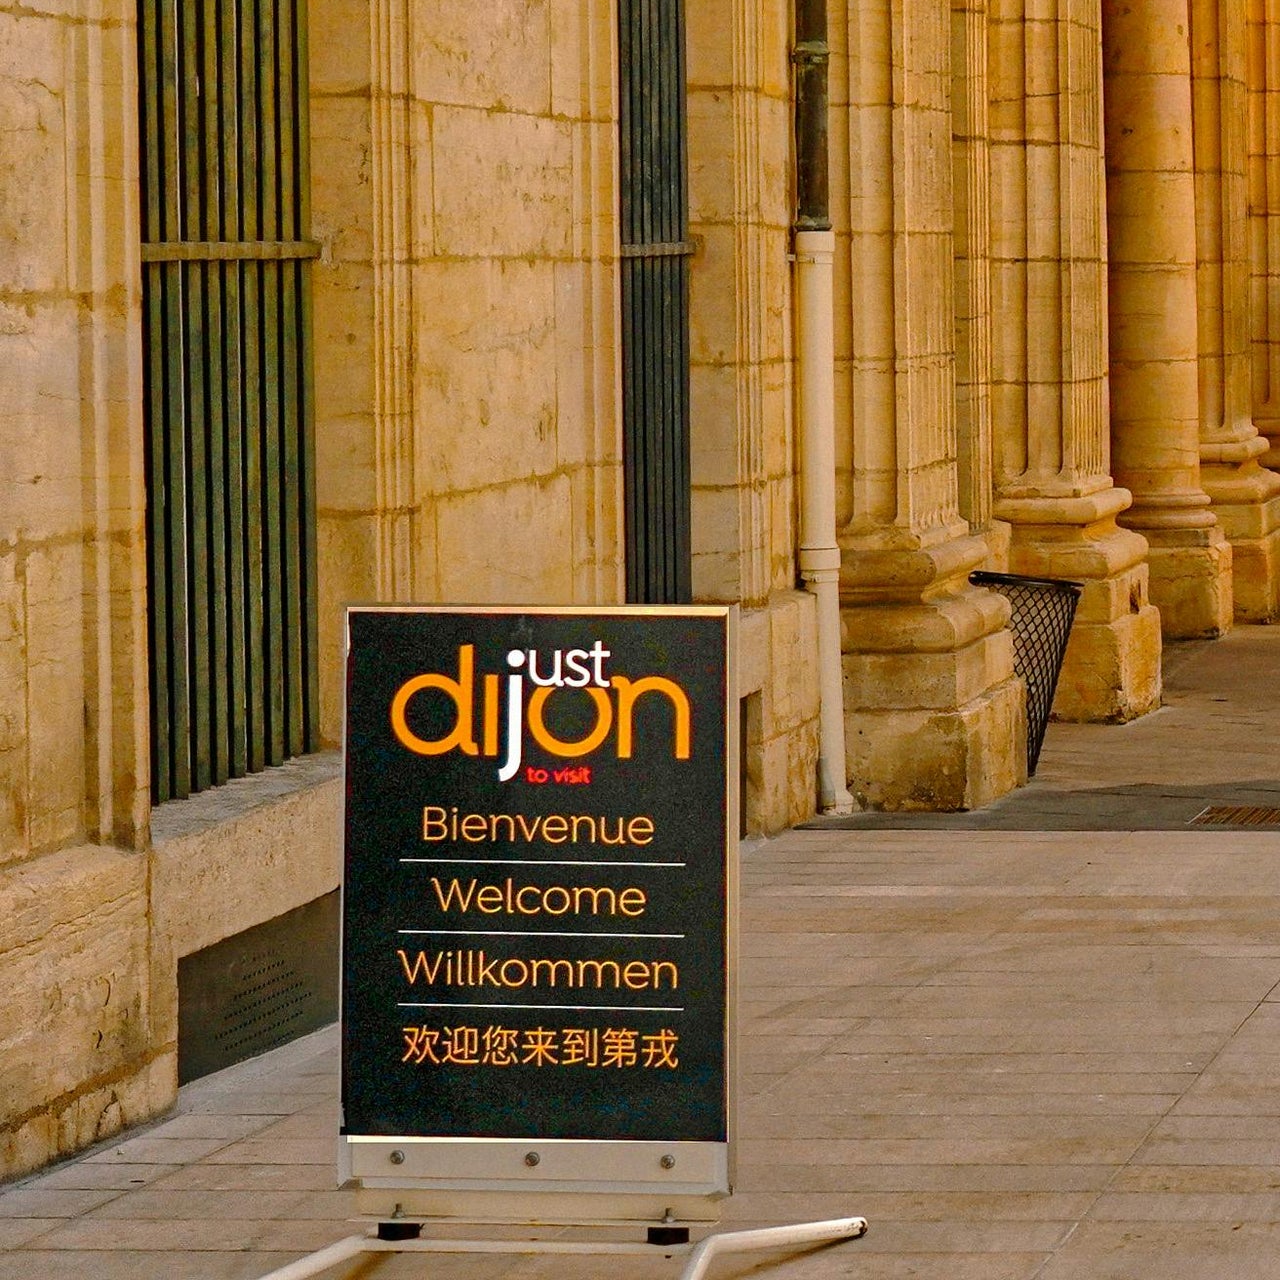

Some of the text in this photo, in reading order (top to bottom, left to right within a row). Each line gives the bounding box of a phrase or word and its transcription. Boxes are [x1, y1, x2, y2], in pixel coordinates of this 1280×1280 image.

[526, 764, 592, 784] to visit
[422, 805, 655, 845] Bienvenue
[430, 877, 647, 916] Welcome
[397, 950, 678, 990] Willkommen
[401, 1025, 679, 1069] 欢迎您来到第戎
